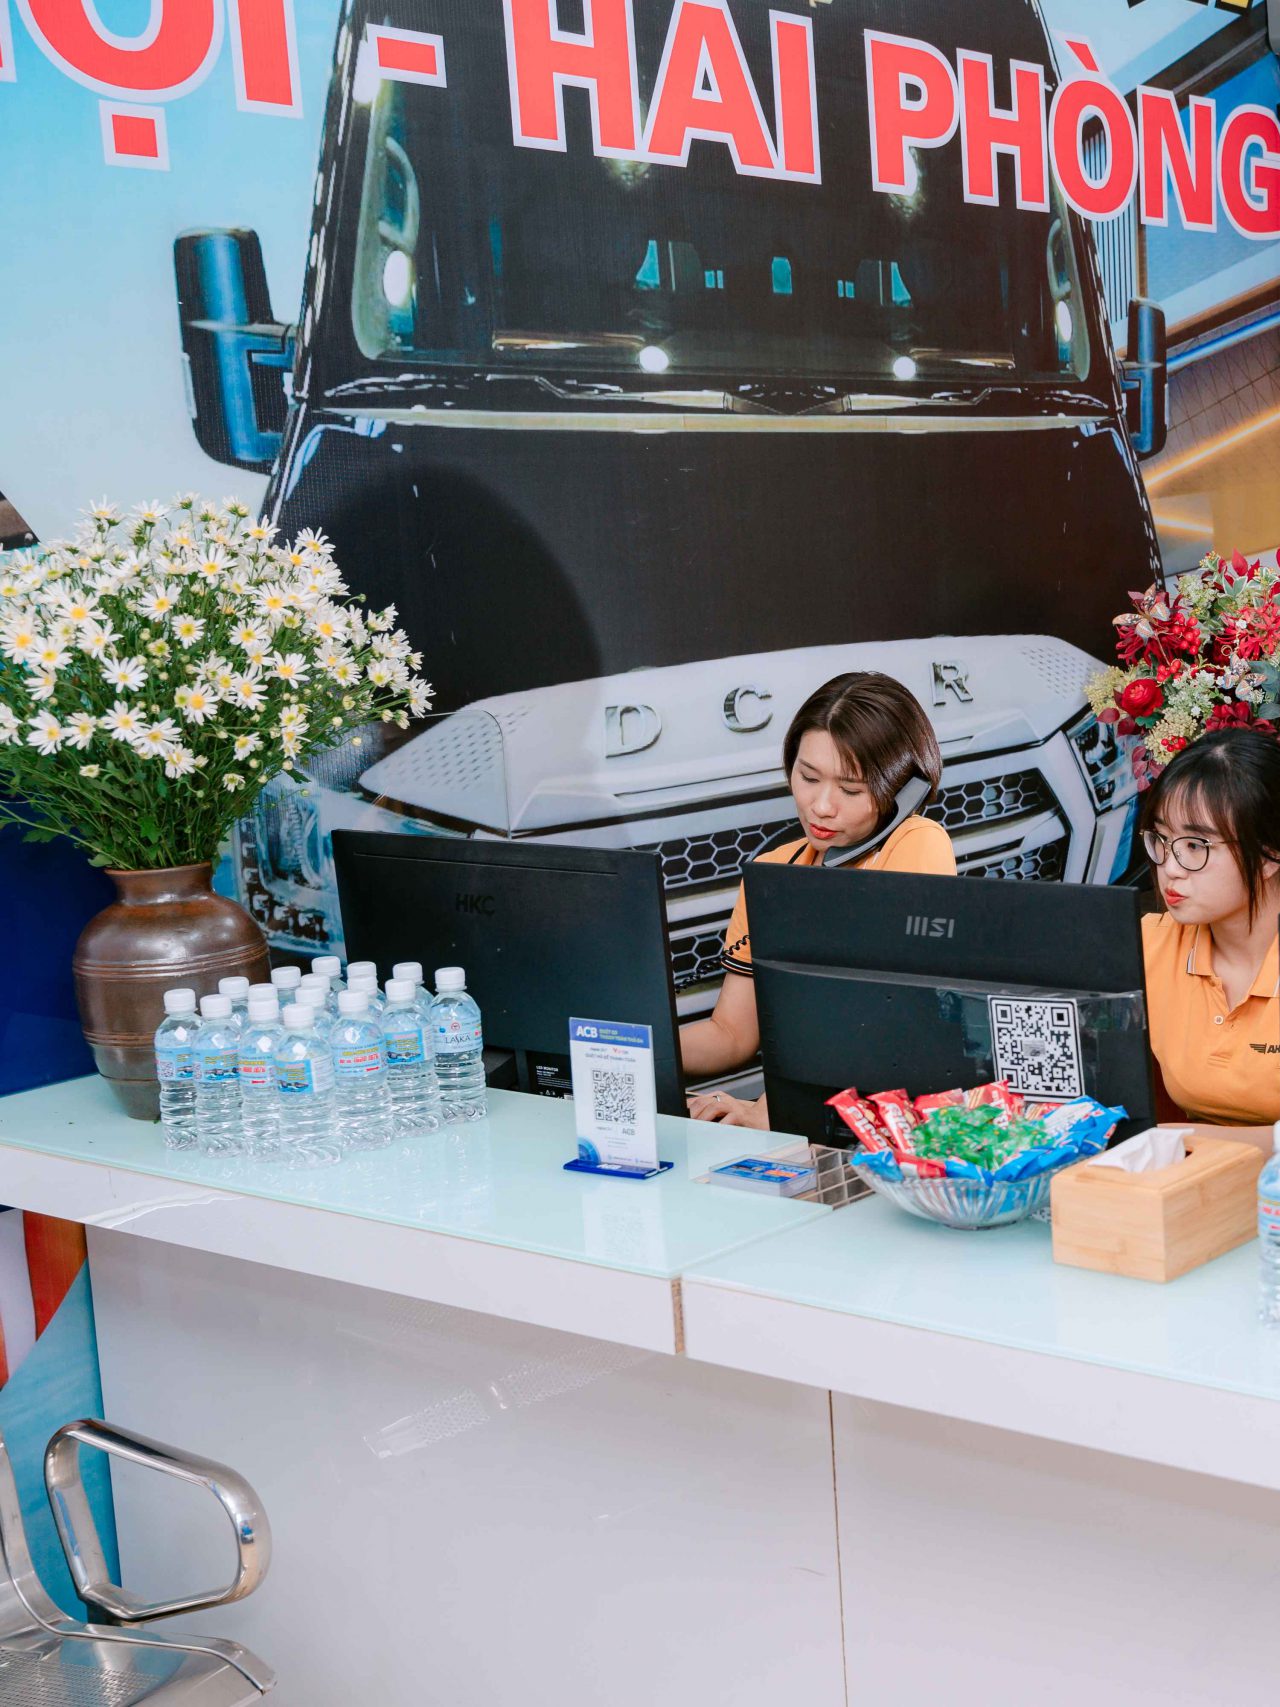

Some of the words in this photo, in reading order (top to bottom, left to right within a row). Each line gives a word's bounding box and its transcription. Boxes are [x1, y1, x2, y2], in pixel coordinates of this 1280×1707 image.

[605, 660, 974, 758] DCR
[456, 893, 495, 916] HKC
[905, 915, 955, 938] MSI
[576, 1025, 598, 1038] ACB
